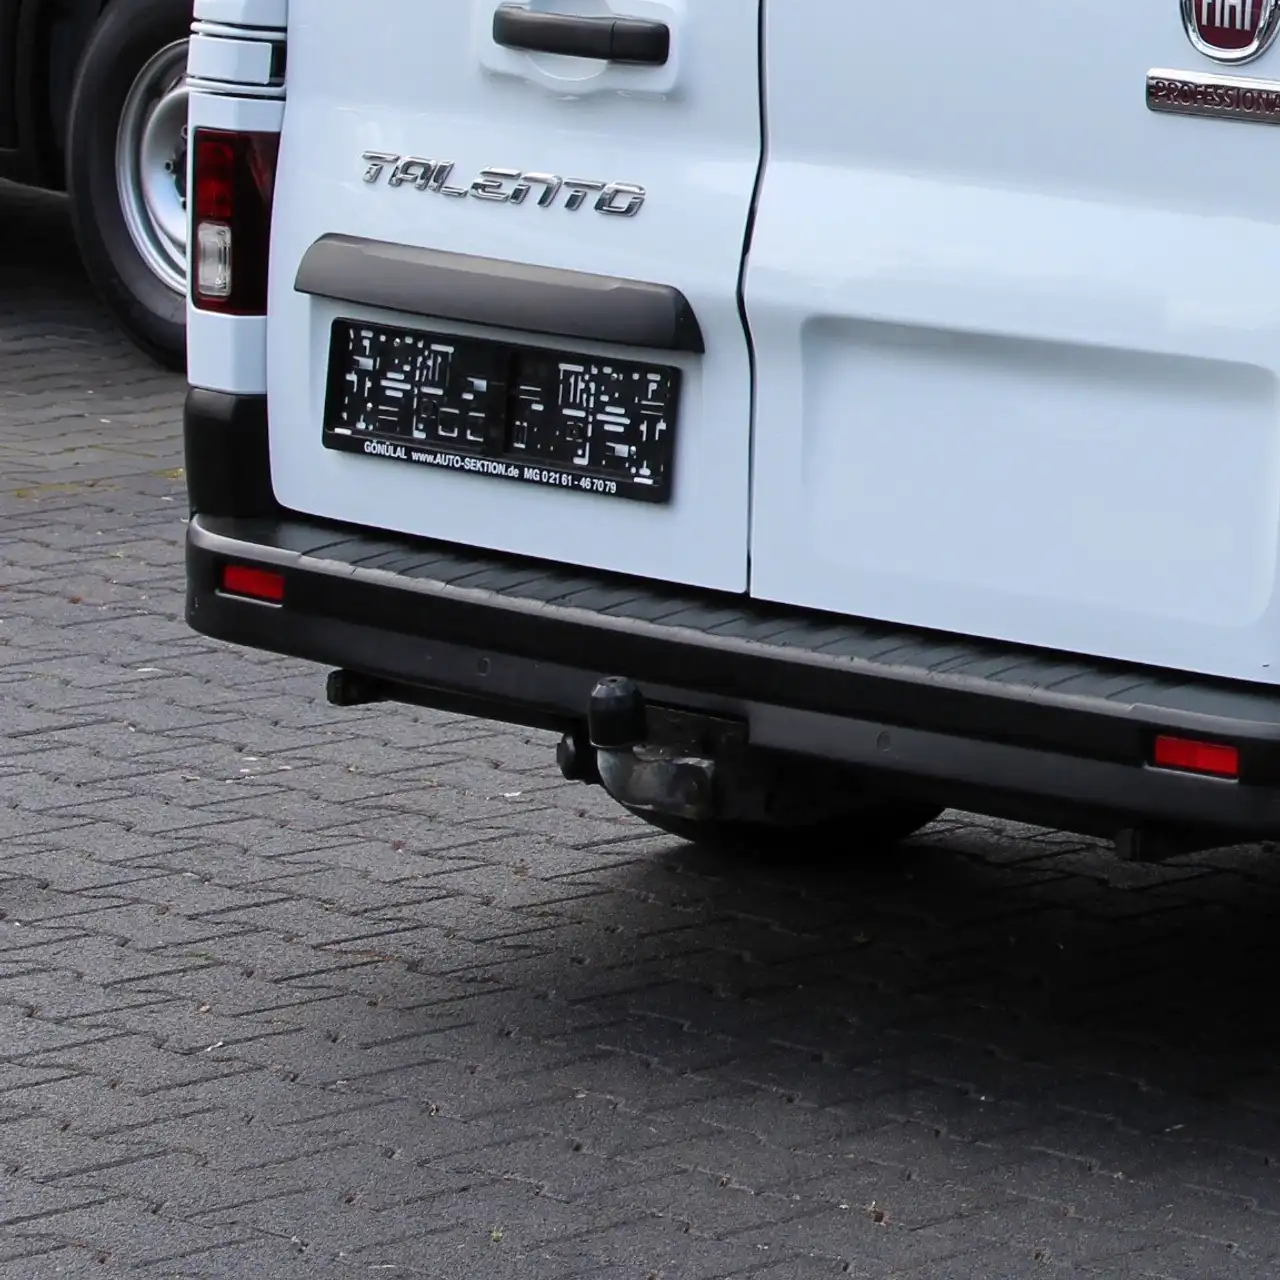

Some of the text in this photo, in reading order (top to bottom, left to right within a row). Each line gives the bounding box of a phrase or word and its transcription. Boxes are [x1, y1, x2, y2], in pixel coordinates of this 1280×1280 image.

[362, 150, 646, 217] TALENTO
[364, 439, 407, 459] GÖNÜLAL
[411, 451, 519, 477] www.AUTO-SEKTION.de
[524, 467, 540, 481] MG
